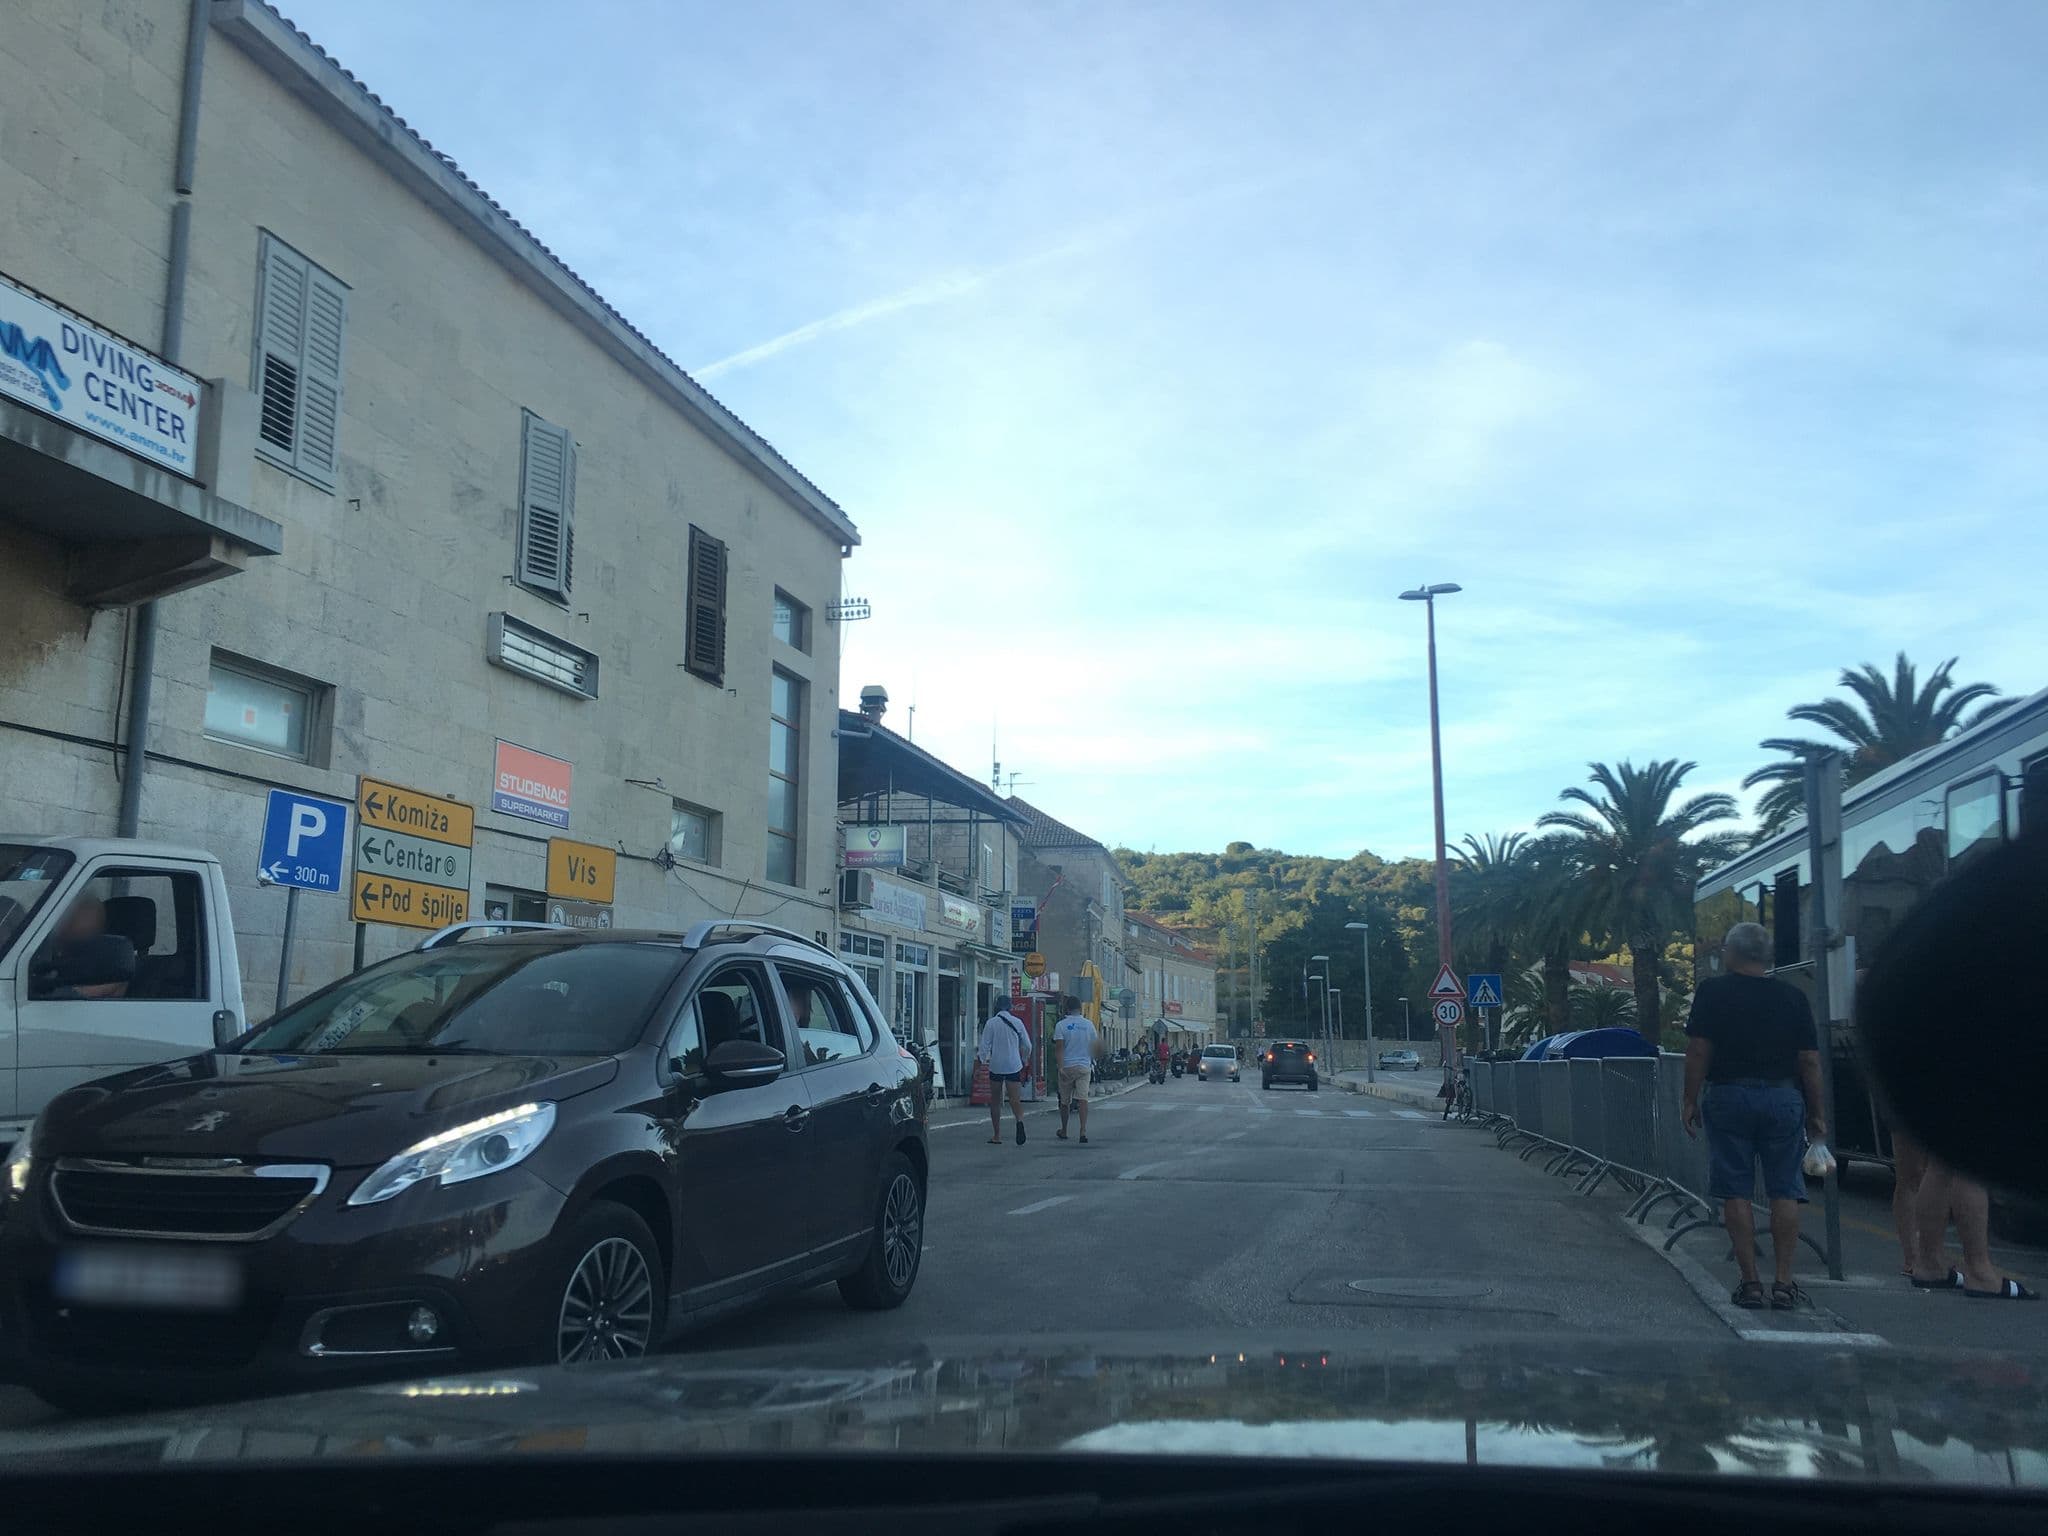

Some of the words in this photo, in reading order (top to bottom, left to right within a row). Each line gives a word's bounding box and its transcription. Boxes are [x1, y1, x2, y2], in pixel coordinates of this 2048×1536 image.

[62, 322, 155, 393] DIVING
[84, 371, 186, 444] CENTER
[85, 411, 187, 464] www.anma.hr
[499, 772, 567, 805] STUDENAC
[386, 793, 449, 833] Komiža
[500, 798, 564, 823] SUPERMARKET
[287, 803, 327, 857] P
[294, 865, 317, 885] 300
[318, 872, 330, 886] m
[383, 839, 442, 875] Centar
[567, 854, 597, 886] Vis
[381, 886, 410, 913] Pod
[421, 892, 463, 925] špilje
[1439, 1005, 1457, 1020] 30
